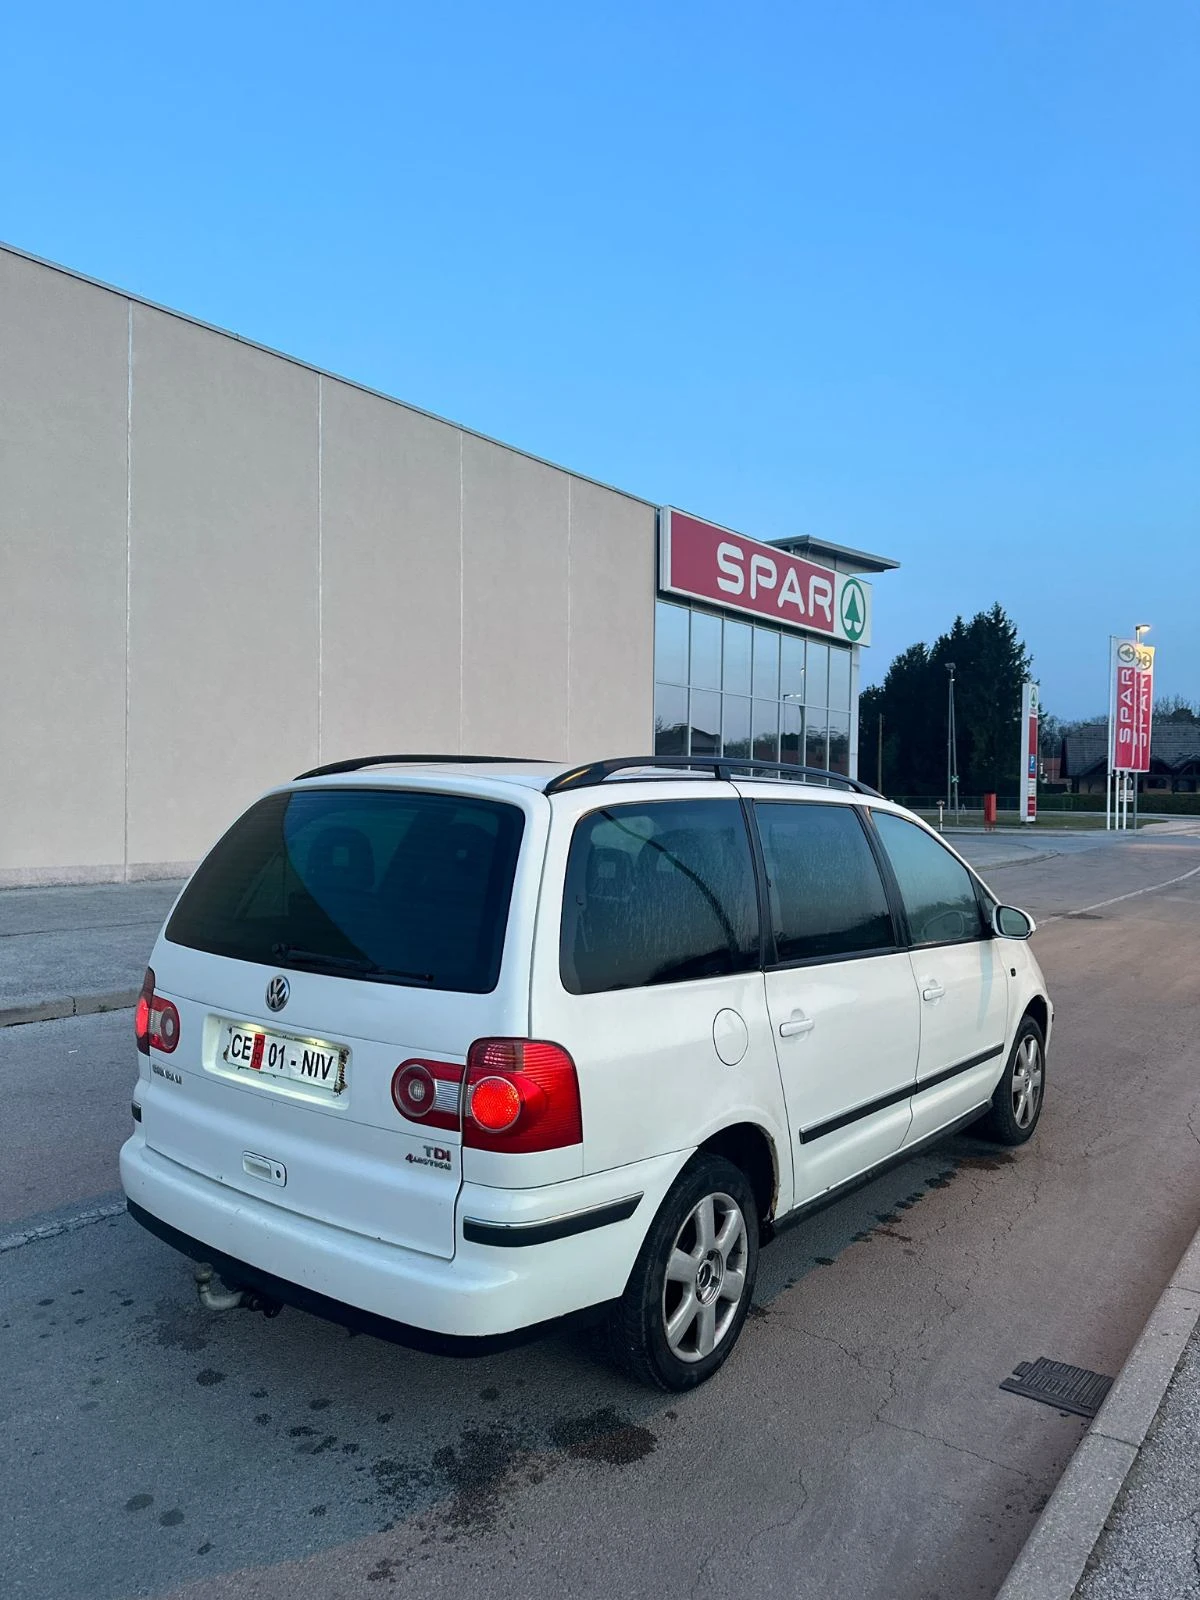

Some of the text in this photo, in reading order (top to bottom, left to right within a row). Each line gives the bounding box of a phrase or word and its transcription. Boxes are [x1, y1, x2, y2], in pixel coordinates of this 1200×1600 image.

[717, 541, 833, 622] SPAR
[1120, 668, 1133, 744] SPAR
[231, 1033, 253, 1060] CE
[423, 1144, 452, 1162] TDI
